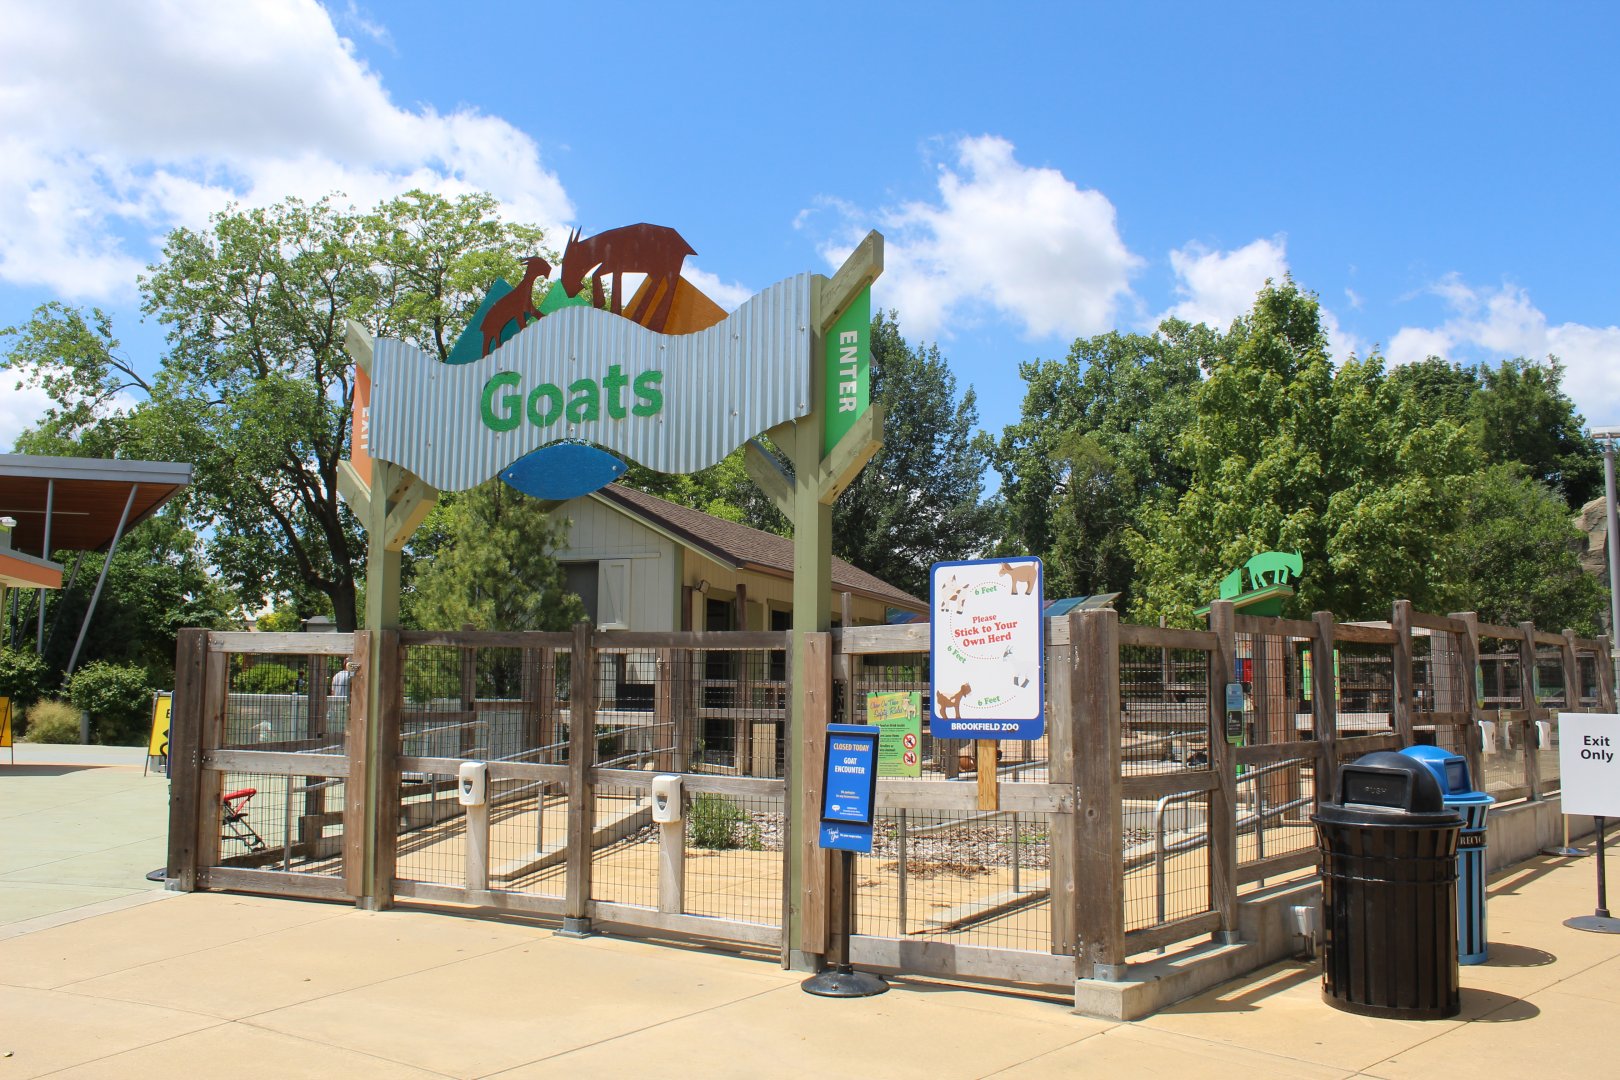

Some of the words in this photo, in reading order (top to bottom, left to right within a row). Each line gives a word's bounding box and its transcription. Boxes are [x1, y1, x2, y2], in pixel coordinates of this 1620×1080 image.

[838, 330, 858, 413] ENTER
[480, 364, 663, 432] Goats
[974, 587, 980, 596] 6
[981, 585, 997, 594] Feet
[972, 614, 997, 624] Please
[954, 626, 979, 638] Stick
[982, 624, 992, 633] to
[994, 620, 1018, 631] Your
[962, 637, 986, 648] Own
[987, 632, 1012, 644] Herd
[952, 648, 967, 664] Feet
[984, 695, 1001, 704] Feet
[951, 722, 1000, 731] BROOKFIELD
[1001, 723, 1019, 731] ZOO
[1583, 735, 1610, 747] Exit
[833, 743, 852, 751] CLOSED
[852, 744, 869, 752] TODAY
[843, 757, 857, 765] GOAT
[1580, 749, 1614, 763] Only
[834, 765, 865, 774] ENCOUNTER
